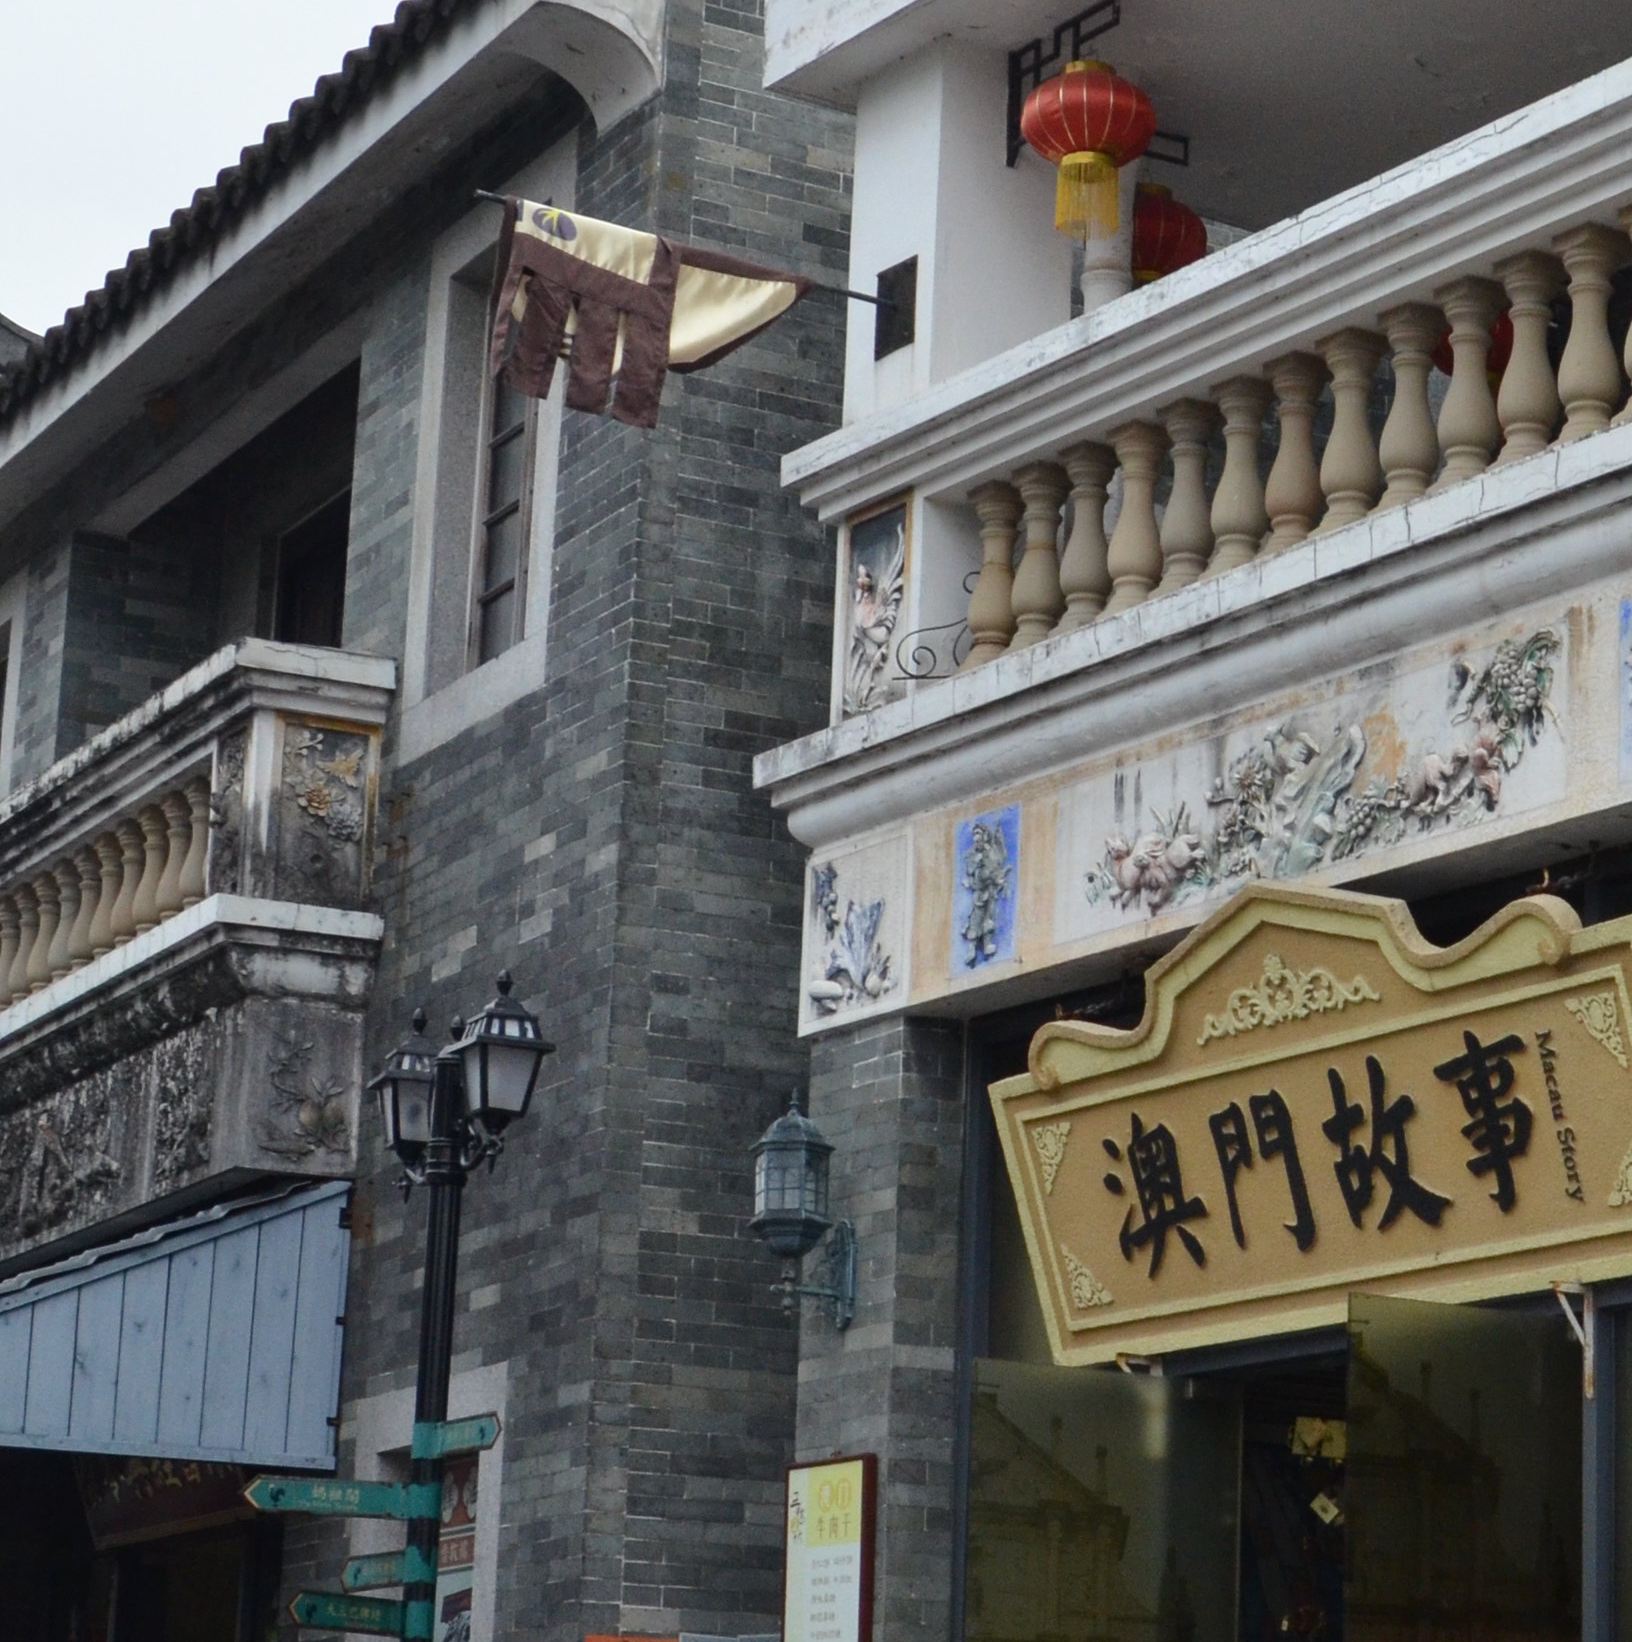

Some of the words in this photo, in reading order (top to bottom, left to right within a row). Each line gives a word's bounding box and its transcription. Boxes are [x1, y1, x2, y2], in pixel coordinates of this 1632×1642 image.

[1102, 1030, 1535, 1278] 澳門故事
[1535, 1029, 1566, 1121] Macau
[1556, 1127, 1585, 1203] Story
